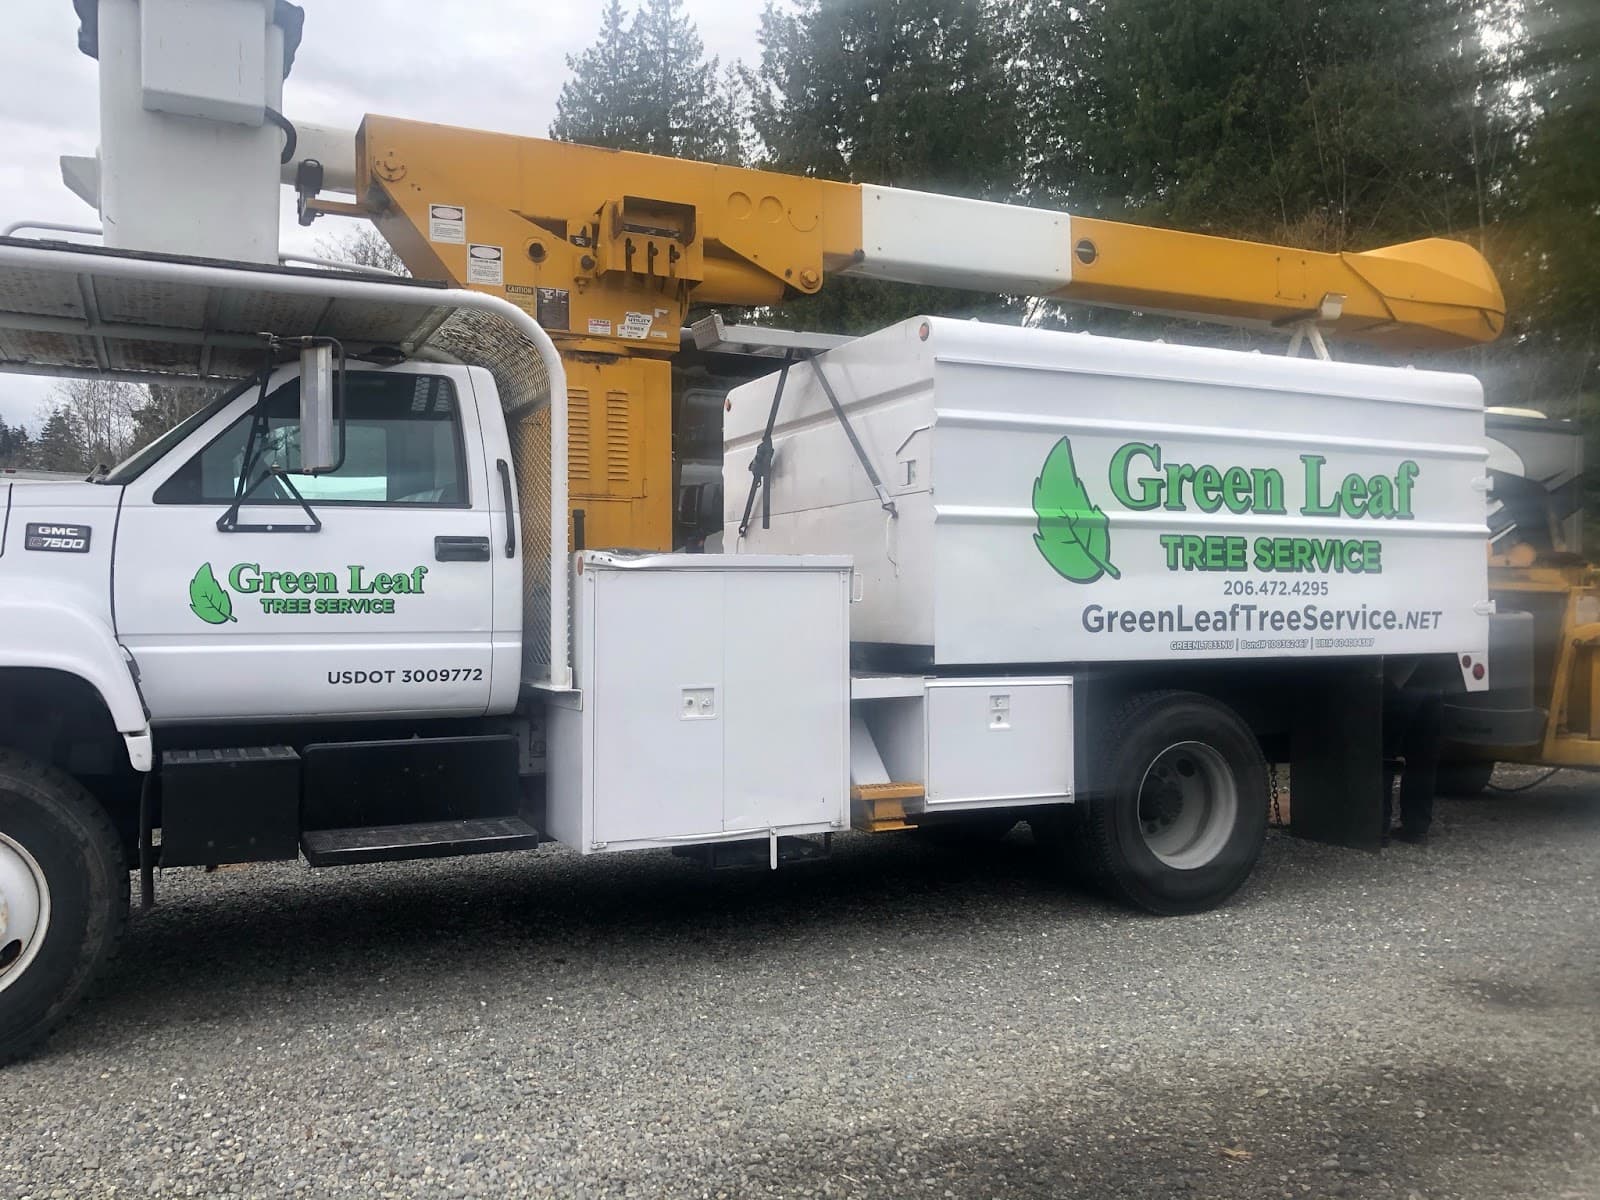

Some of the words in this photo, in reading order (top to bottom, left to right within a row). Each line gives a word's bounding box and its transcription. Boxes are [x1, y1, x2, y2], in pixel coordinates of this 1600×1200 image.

[1108, 441, 1287, 516] Green
[1300, 454, 1420, 520] Leaf
[38, 526, 78, 536] GMC
[1159, 534, 1248, 571] TREE
[1253, 537, 1382, 574] SERVICE
[228, 563, 339, 594] Green
[347, 565, 428, 594] Leaf
[1223, 580, 1329, 596] 206.472.4295
[260, 598, 311, 614] TREE
[314, 598, 395, 614] SERVICE
[1081, 603, 1443, 634] GreenLeafTreeService.NET
[327, 670, 395, 685] USDOT
[401, 668, 483, 683] 3009772
